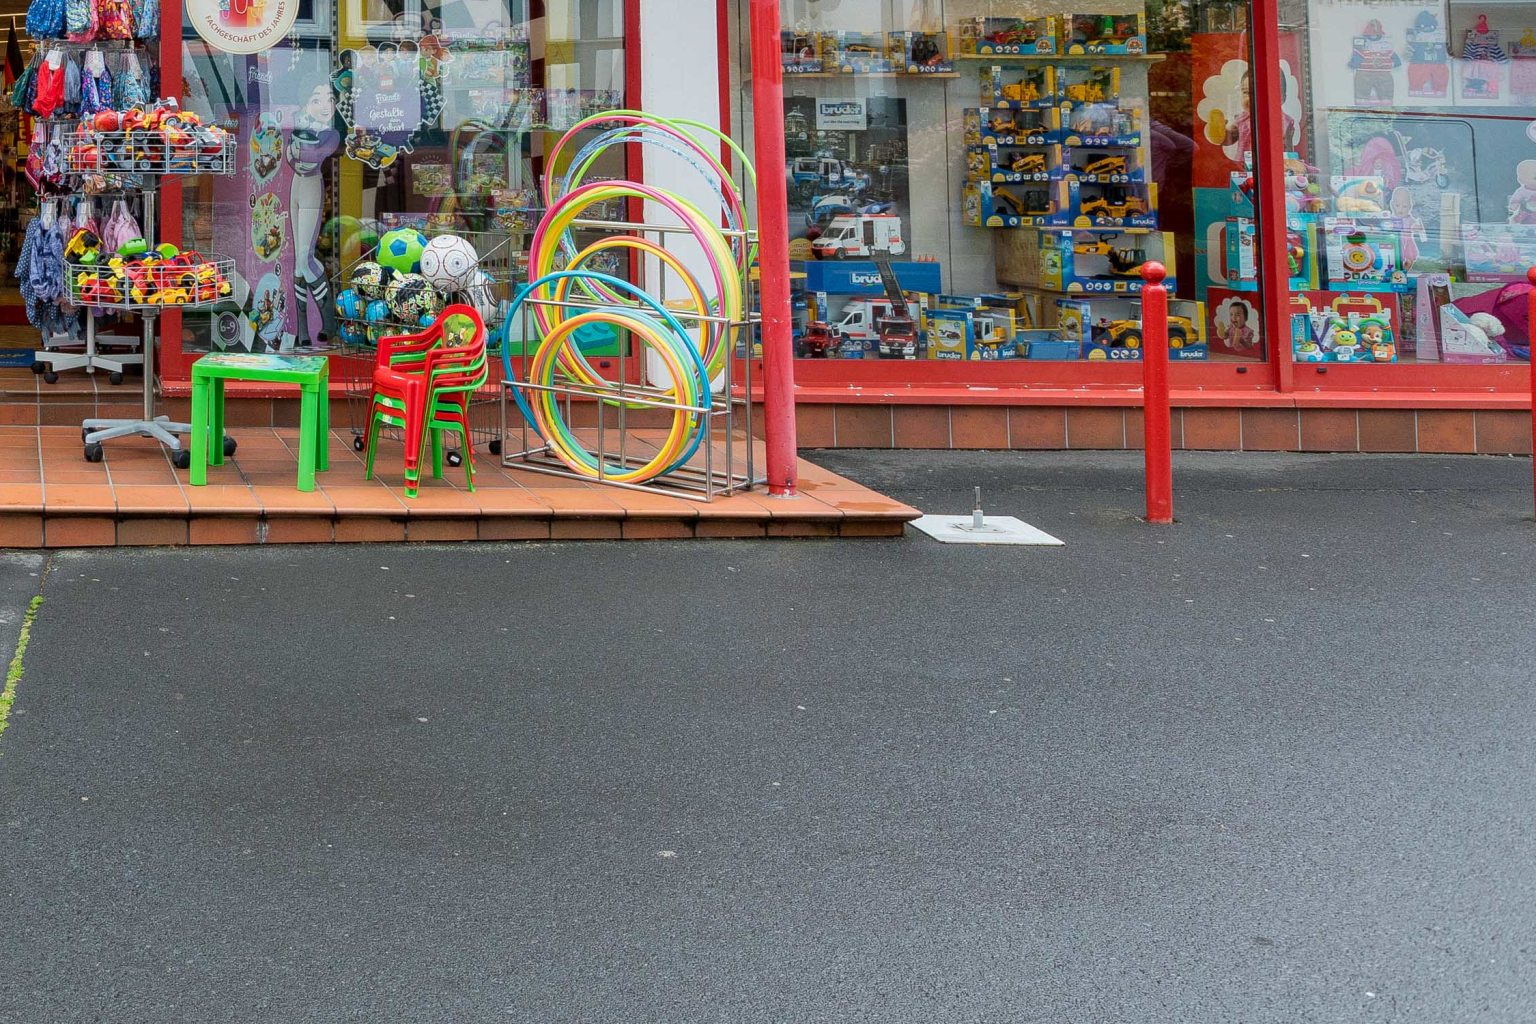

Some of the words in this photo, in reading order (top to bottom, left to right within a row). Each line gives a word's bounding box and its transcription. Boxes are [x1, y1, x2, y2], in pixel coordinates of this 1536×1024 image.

[258, 27, 273, 39] DES
[271, 1, 286, 28] JAHRES
[369, 107, 405, 121] Gestalte
[821, 103, 861, 115] bruder
[1131, 218, 1155, 226] bruder
[851, 273, 883, 284] brud
[219, 319, 237, 333] 6-9
[936, 351, 962, 359] bruder
[1180, 350, 1204, 358] bruder
